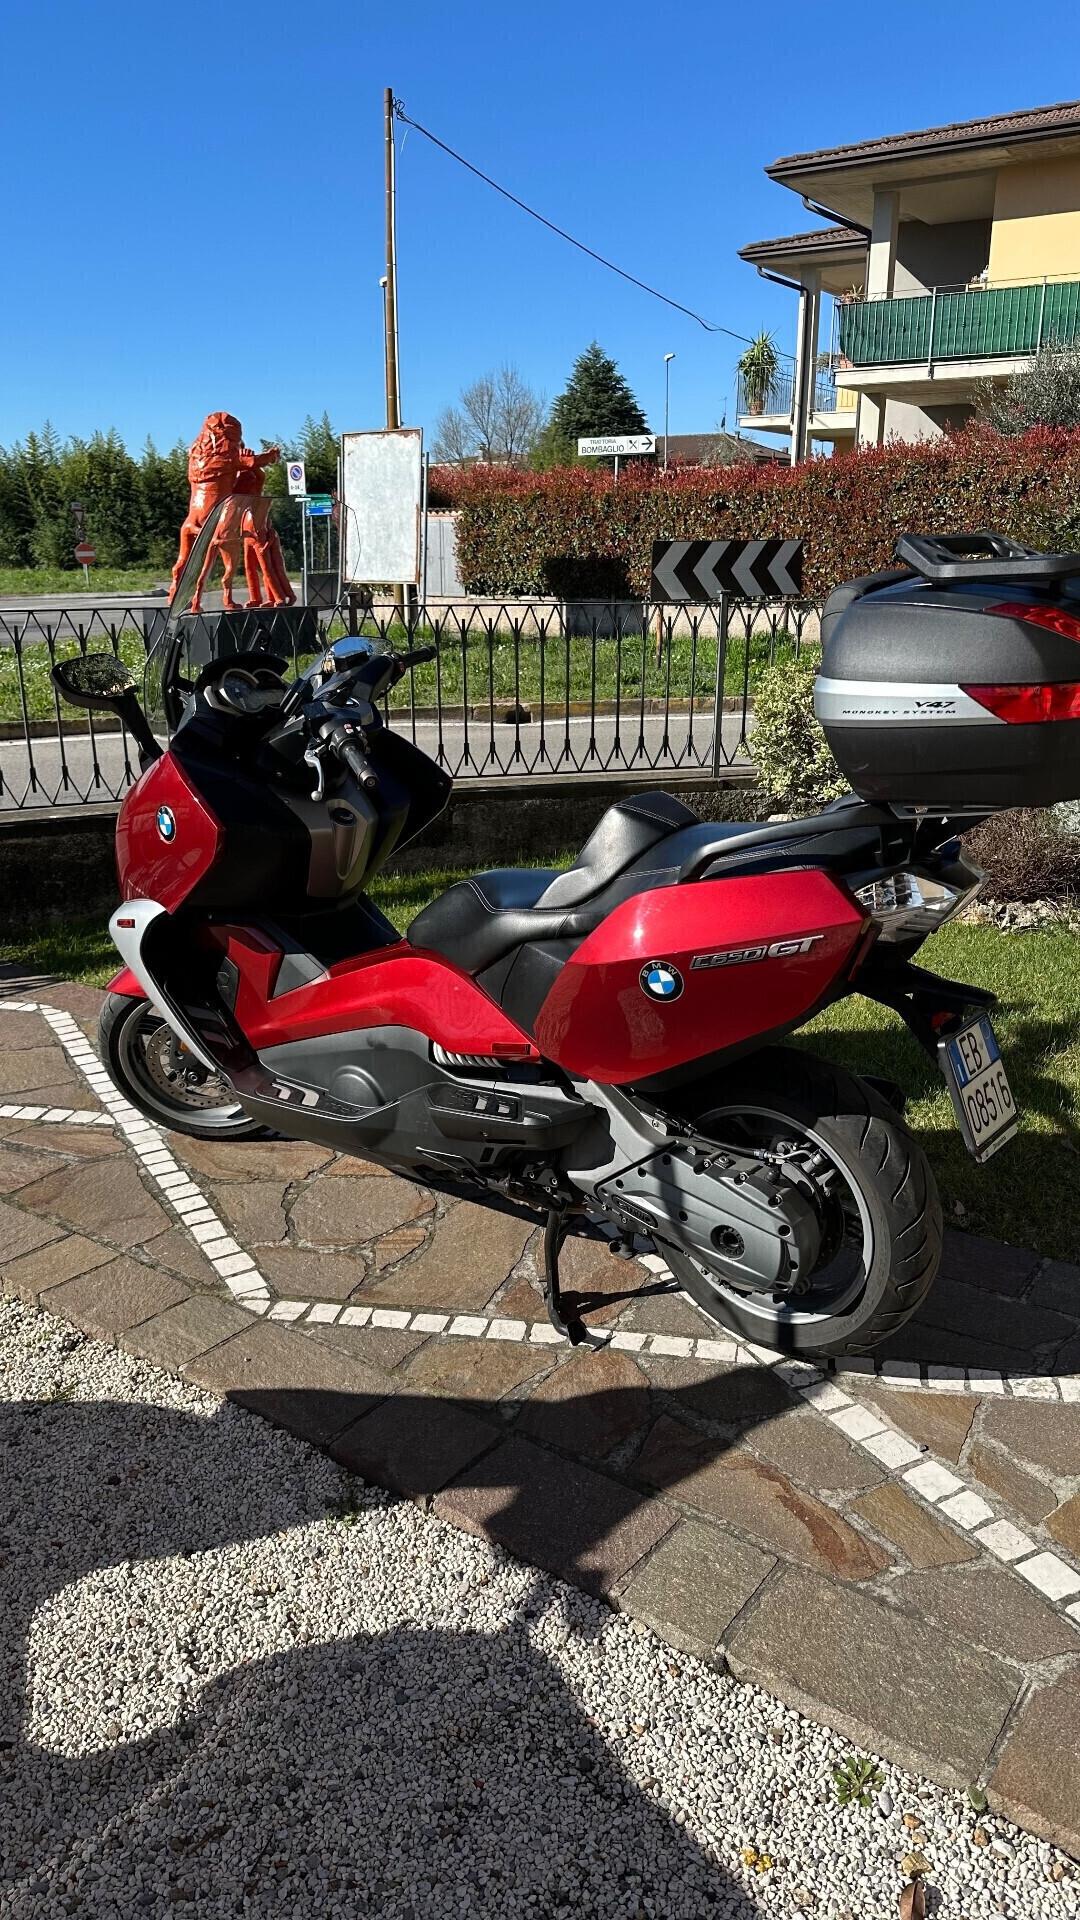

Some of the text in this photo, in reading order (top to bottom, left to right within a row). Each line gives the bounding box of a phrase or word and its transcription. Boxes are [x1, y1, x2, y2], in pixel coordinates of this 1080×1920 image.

[581, 445, 624, 453] BOMBAGLIO
[767, 935, 825, 958] GT
[959, 1032, 982, 1076] EB
[967, 1071, 1011, 1134] 08516
